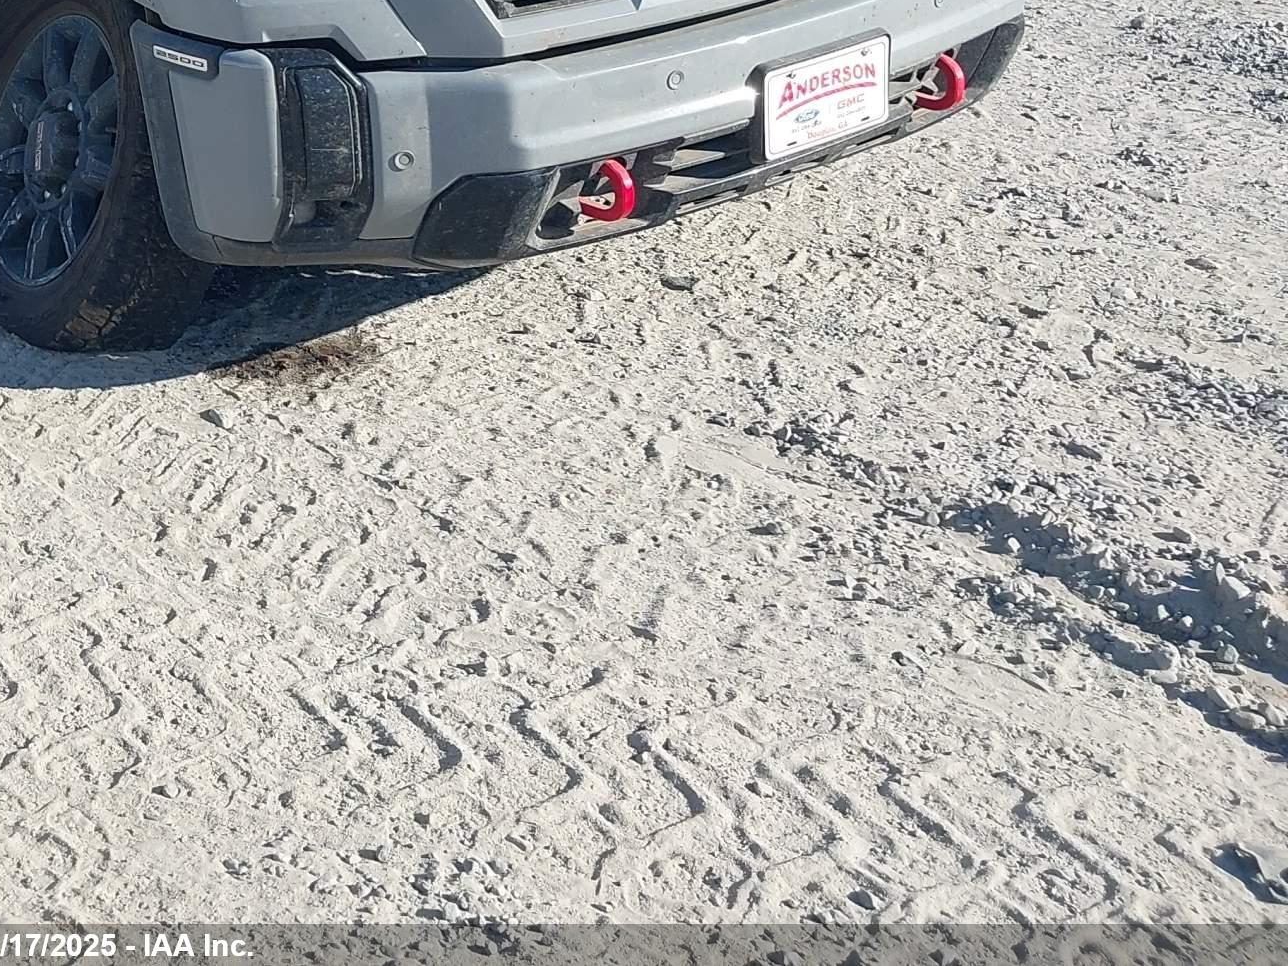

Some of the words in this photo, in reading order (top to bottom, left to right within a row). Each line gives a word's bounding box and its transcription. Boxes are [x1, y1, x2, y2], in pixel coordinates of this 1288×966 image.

[155, 48, 205, 68] 2500
[778, 63, 875, 109] ANDERSON
[837, 93, 865, 110] GMC
